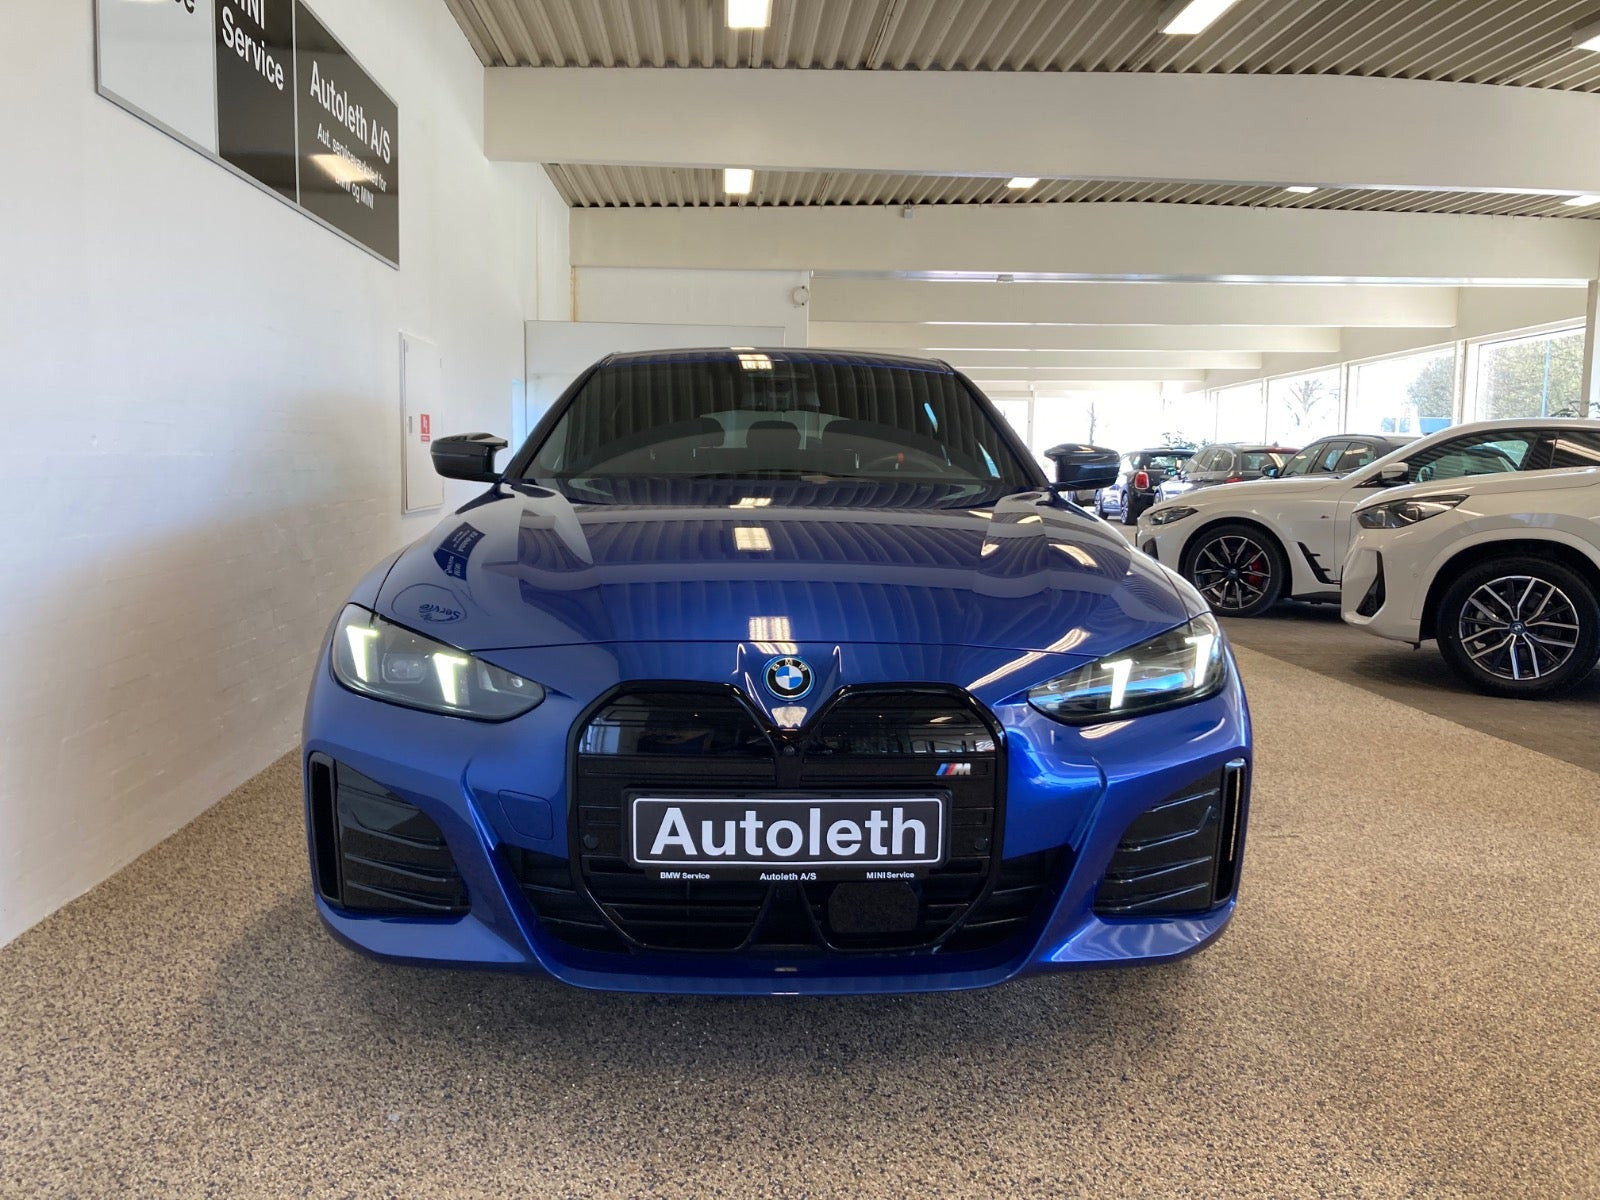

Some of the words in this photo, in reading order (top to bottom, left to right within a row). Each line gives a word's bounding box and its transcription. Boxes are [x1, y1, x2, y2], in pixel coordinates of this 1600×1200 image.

[222, 6, 284, 91] Service
[310, 60, 368, 145] Autoleth
[371, 119, 391, 164] A/S
[771, 658, 808, 672] BMW
[650, 807, 927, 857] Autoleth
[660, 871, 681, 880] BMW
[682, 871, 711, 880] Service
[760, 872, 798, 881] Autoleth
[799, 872, 817, 881] A/S
[866, 871, 886, 880] MINI
[886, 870, 915, 879] Service
